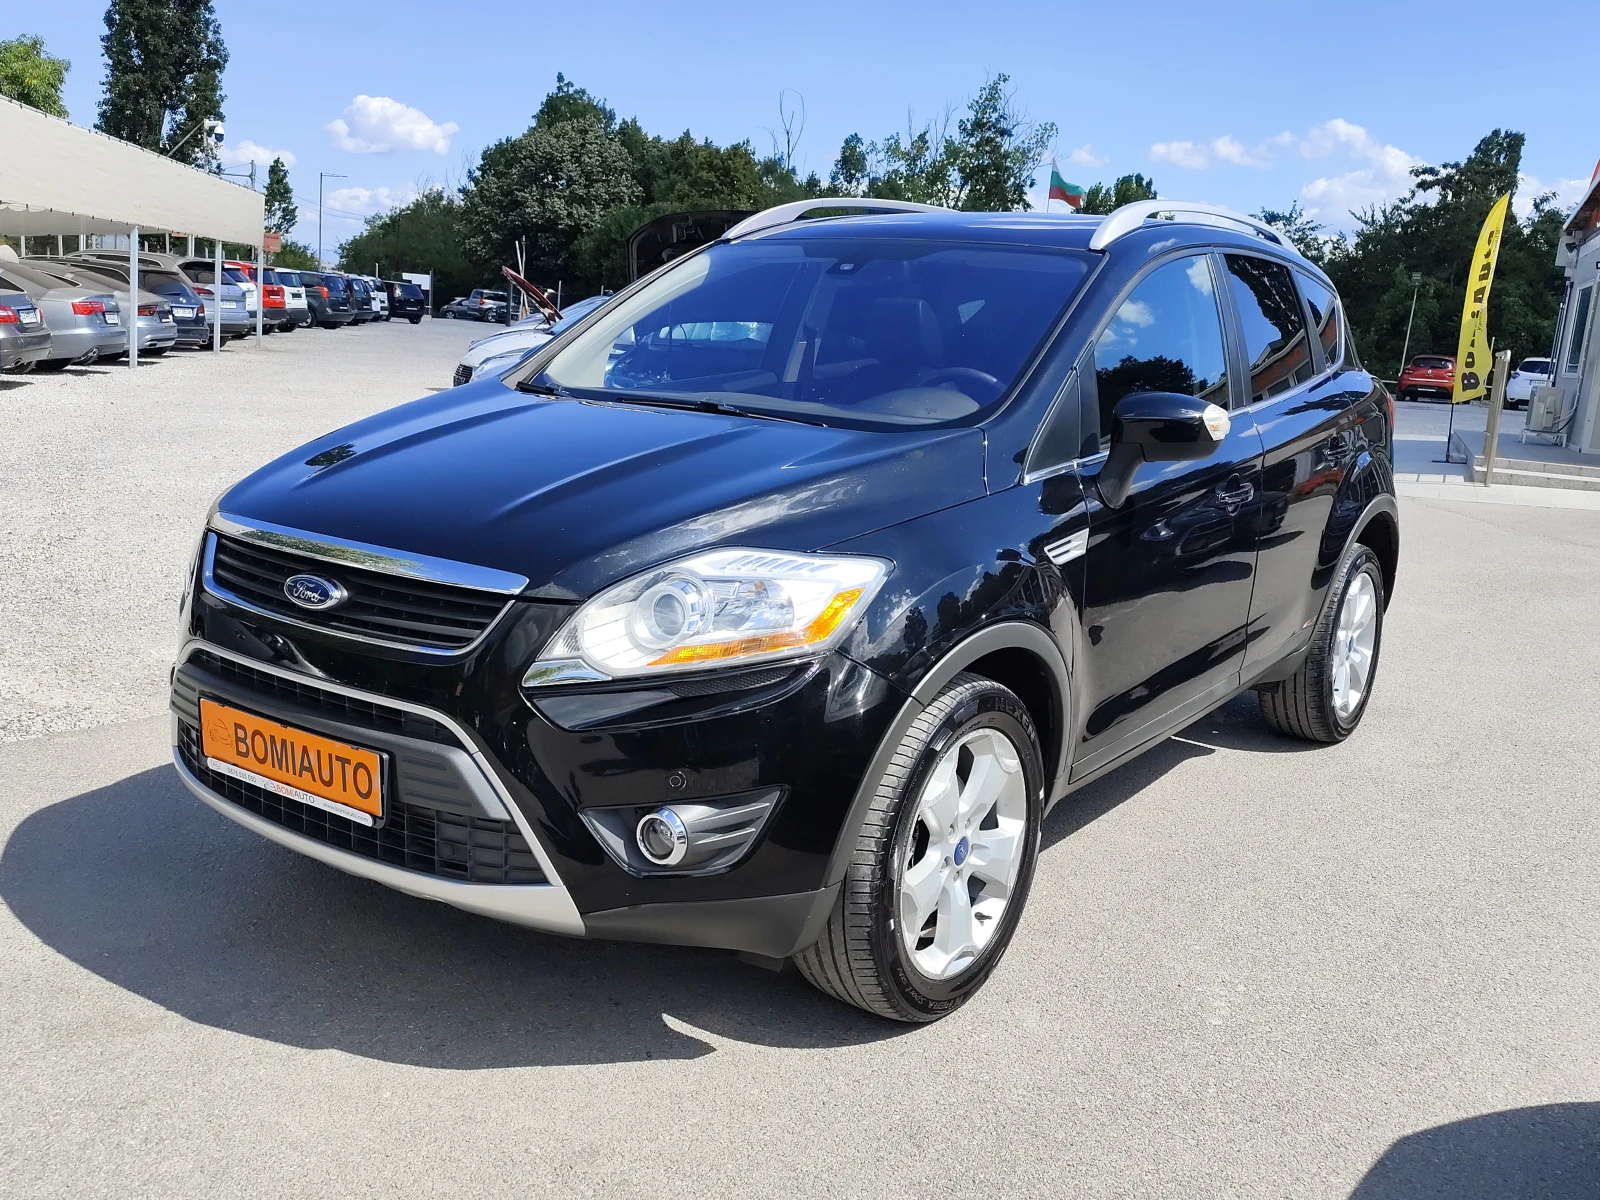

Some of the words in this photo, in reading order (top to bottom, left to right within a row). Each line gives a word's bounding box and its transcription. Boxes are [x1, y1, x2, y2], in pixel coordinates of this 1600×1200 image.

[293, 580, 325, 602] Ford
[995, 697, 1036, 742] NEXEN
[233, 722, 373, 800] BOMIAUTO
[276, 784, 315, 804] BOMIAUTO
[904, 986, 928, 1005] Sport
